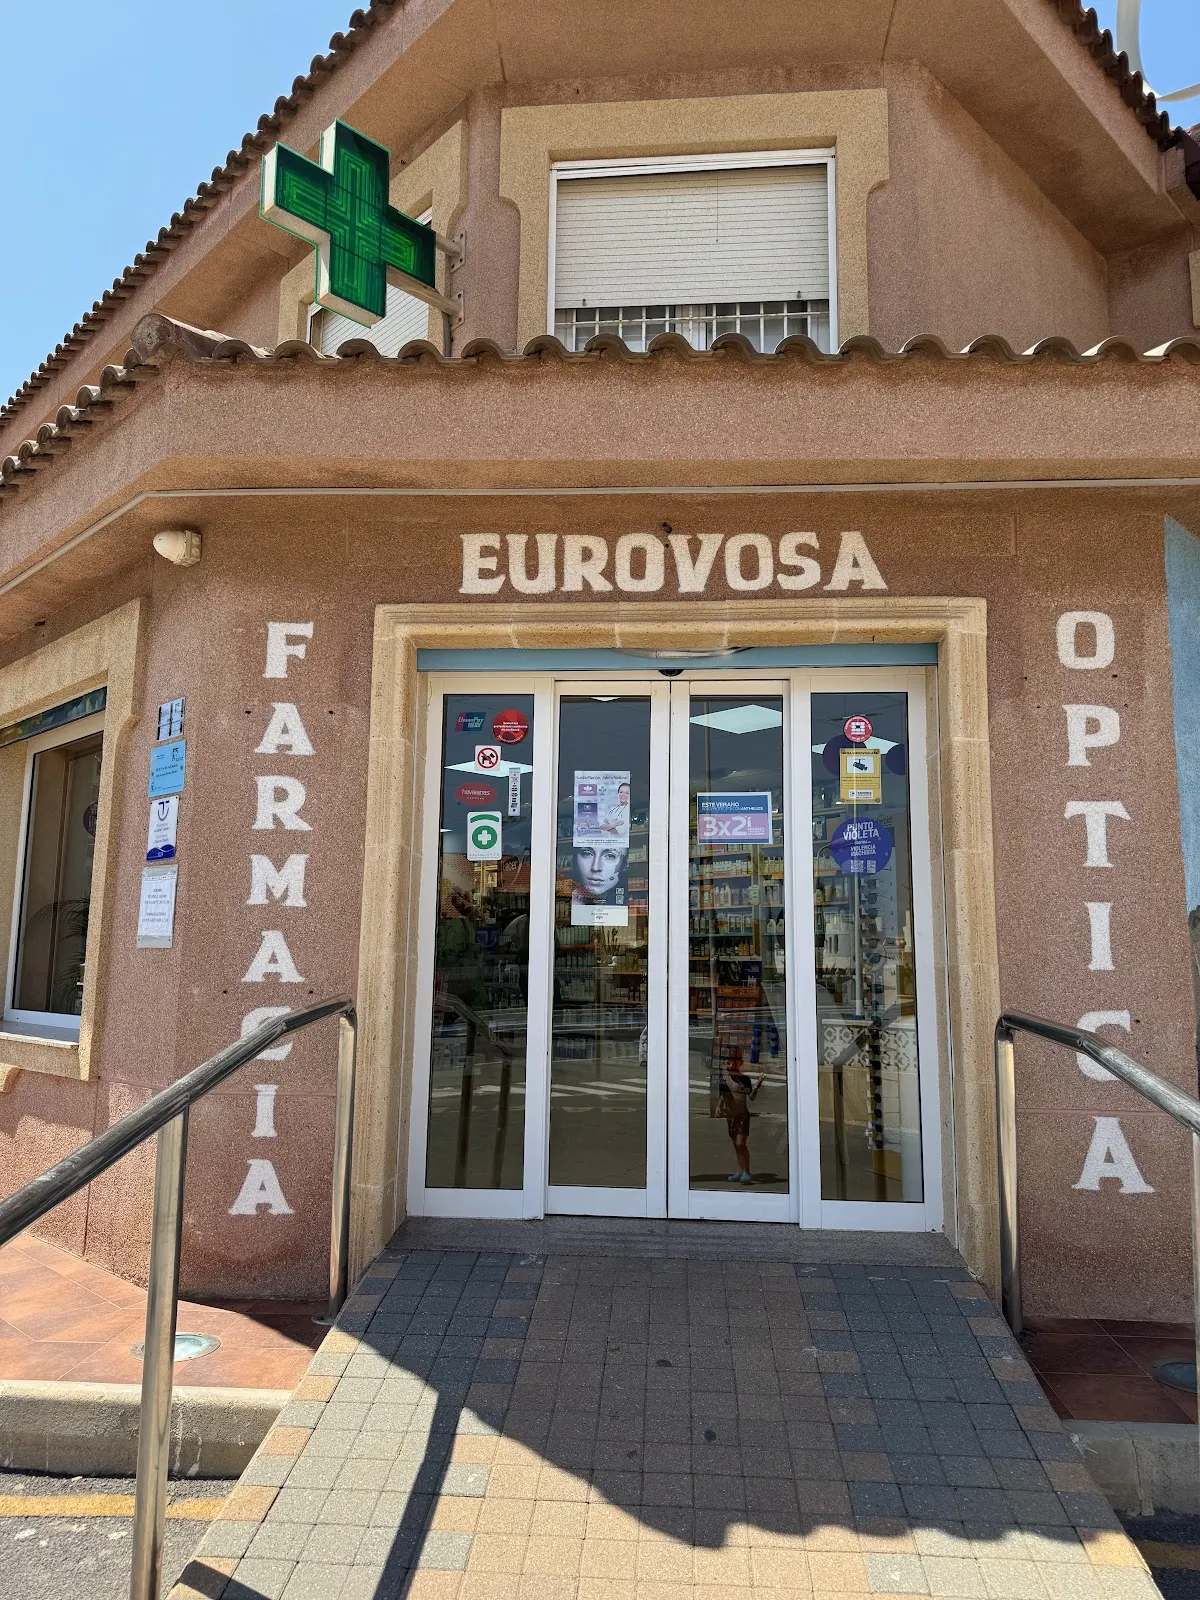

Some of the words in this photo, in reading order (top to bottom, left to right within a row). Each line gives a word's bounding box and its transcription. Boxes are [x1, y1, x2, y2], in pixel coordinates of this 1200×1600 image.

[459, 531, 888, 594] EUROVOSA
[458, 716, 484, 725] UnionPay
[703, 816, 747, 837] 3x2
[843, 828, 880, 841] VIOLETA
[847, 821, 874, 832] PUNTO
[850, 844, 877, 852] VIOLENCIA
[1056, 611, 1155, 1194] OPTICA
[228, 622, 316, 1215] FARMACIA
